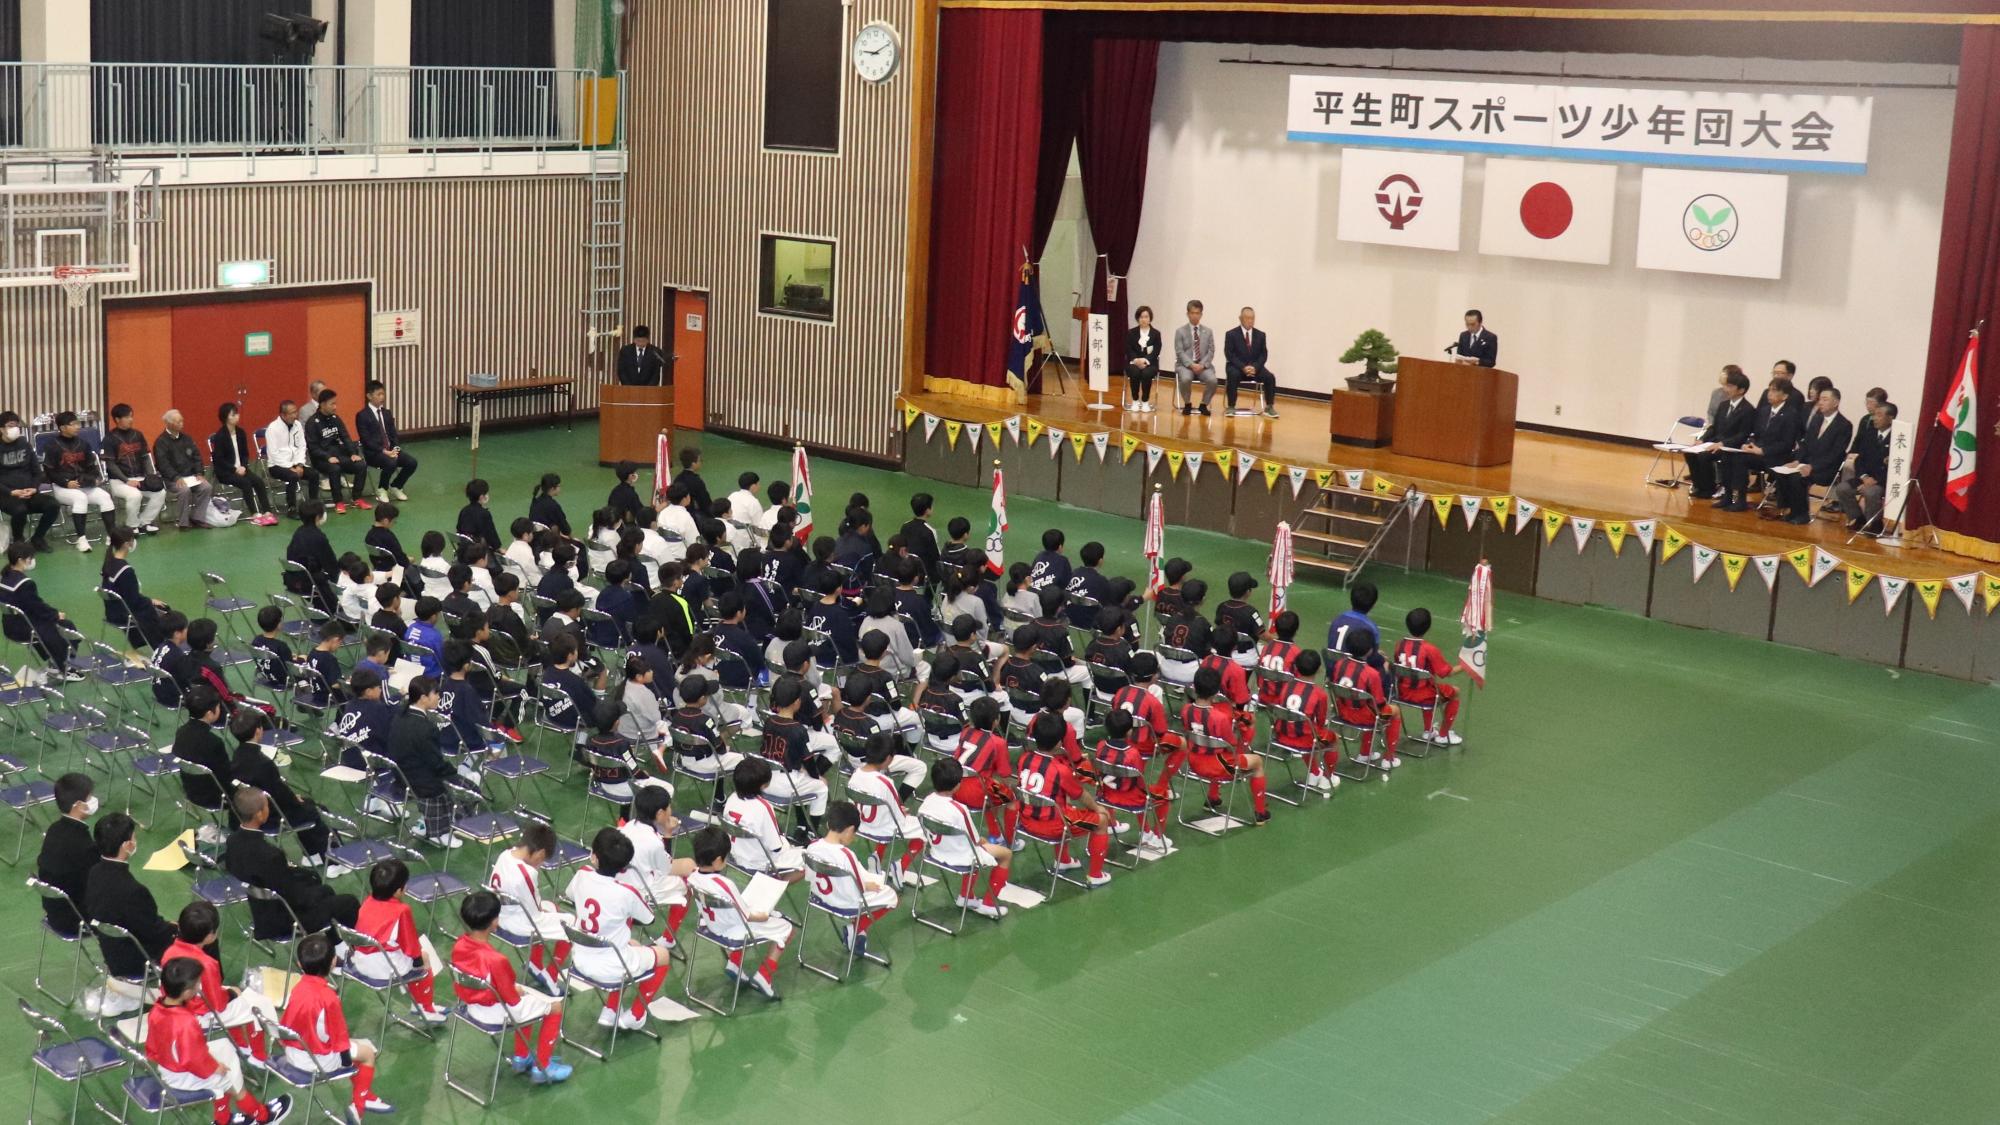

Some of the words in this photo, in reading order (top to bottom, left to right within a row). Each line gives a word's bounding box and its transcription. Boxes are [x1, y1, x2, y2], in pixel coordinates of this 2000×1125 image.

[1311, 90, 1835, 152] 平生町スポーツ少年団大会
[1092, 318, 1104, 370] 本部席
[1172, 624, 1189, 648] 8
[1336, 625, 1349, 650] 1
[958, 741, 977, 768] 7
[581, 897, 600, 934] 3
